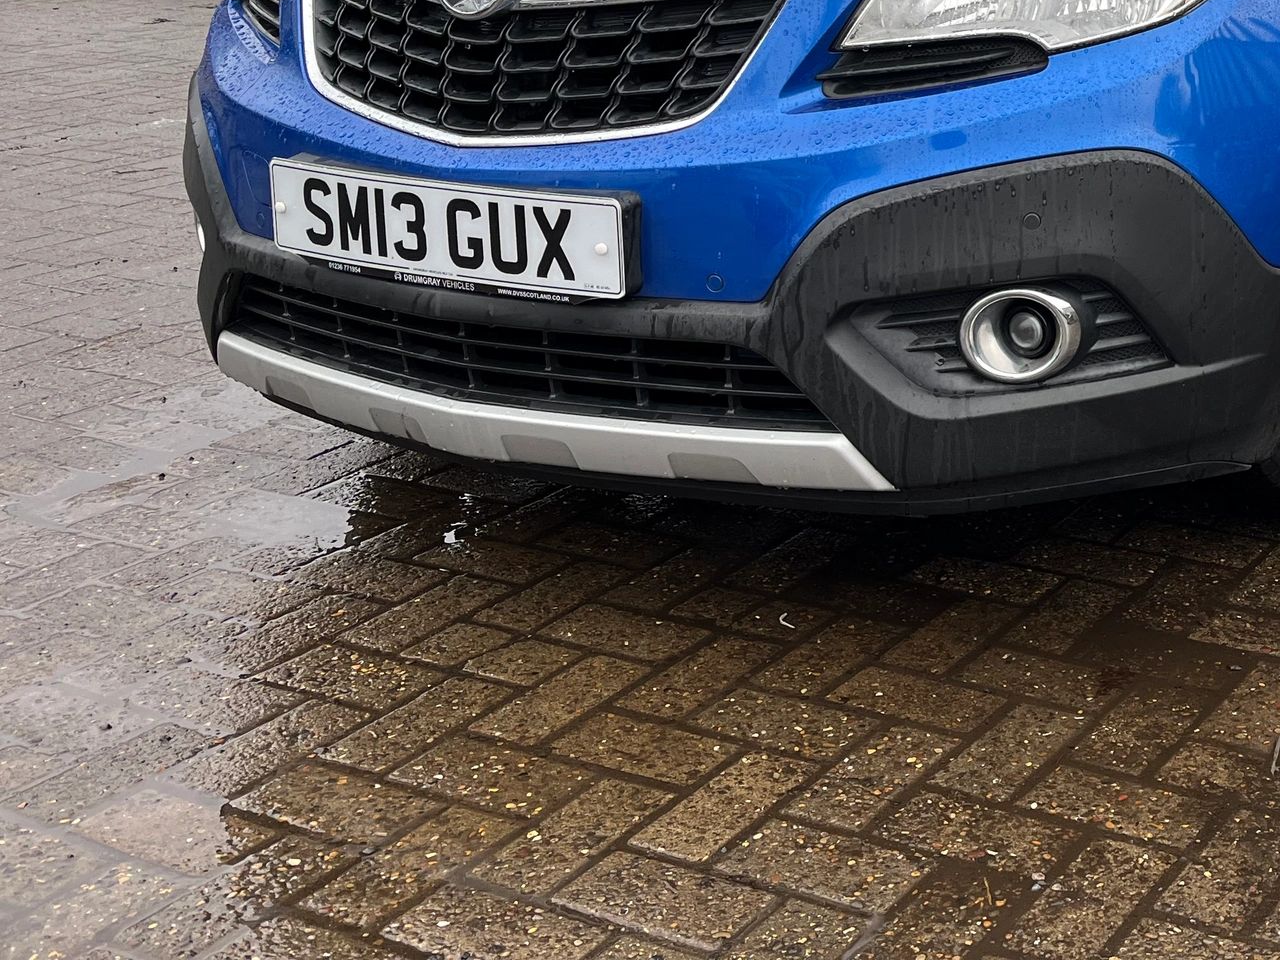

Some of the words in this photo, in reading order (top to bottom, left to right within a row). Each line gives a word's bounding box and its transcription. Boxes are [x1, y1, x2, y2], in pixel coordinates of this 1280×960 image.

[303, 177, 428, 263] SM13
[446, 198, 576, 282] GUX
[403, 273, 441, 287] DRUMGRAY
[442, 279, 475, 291] VEHICLES
